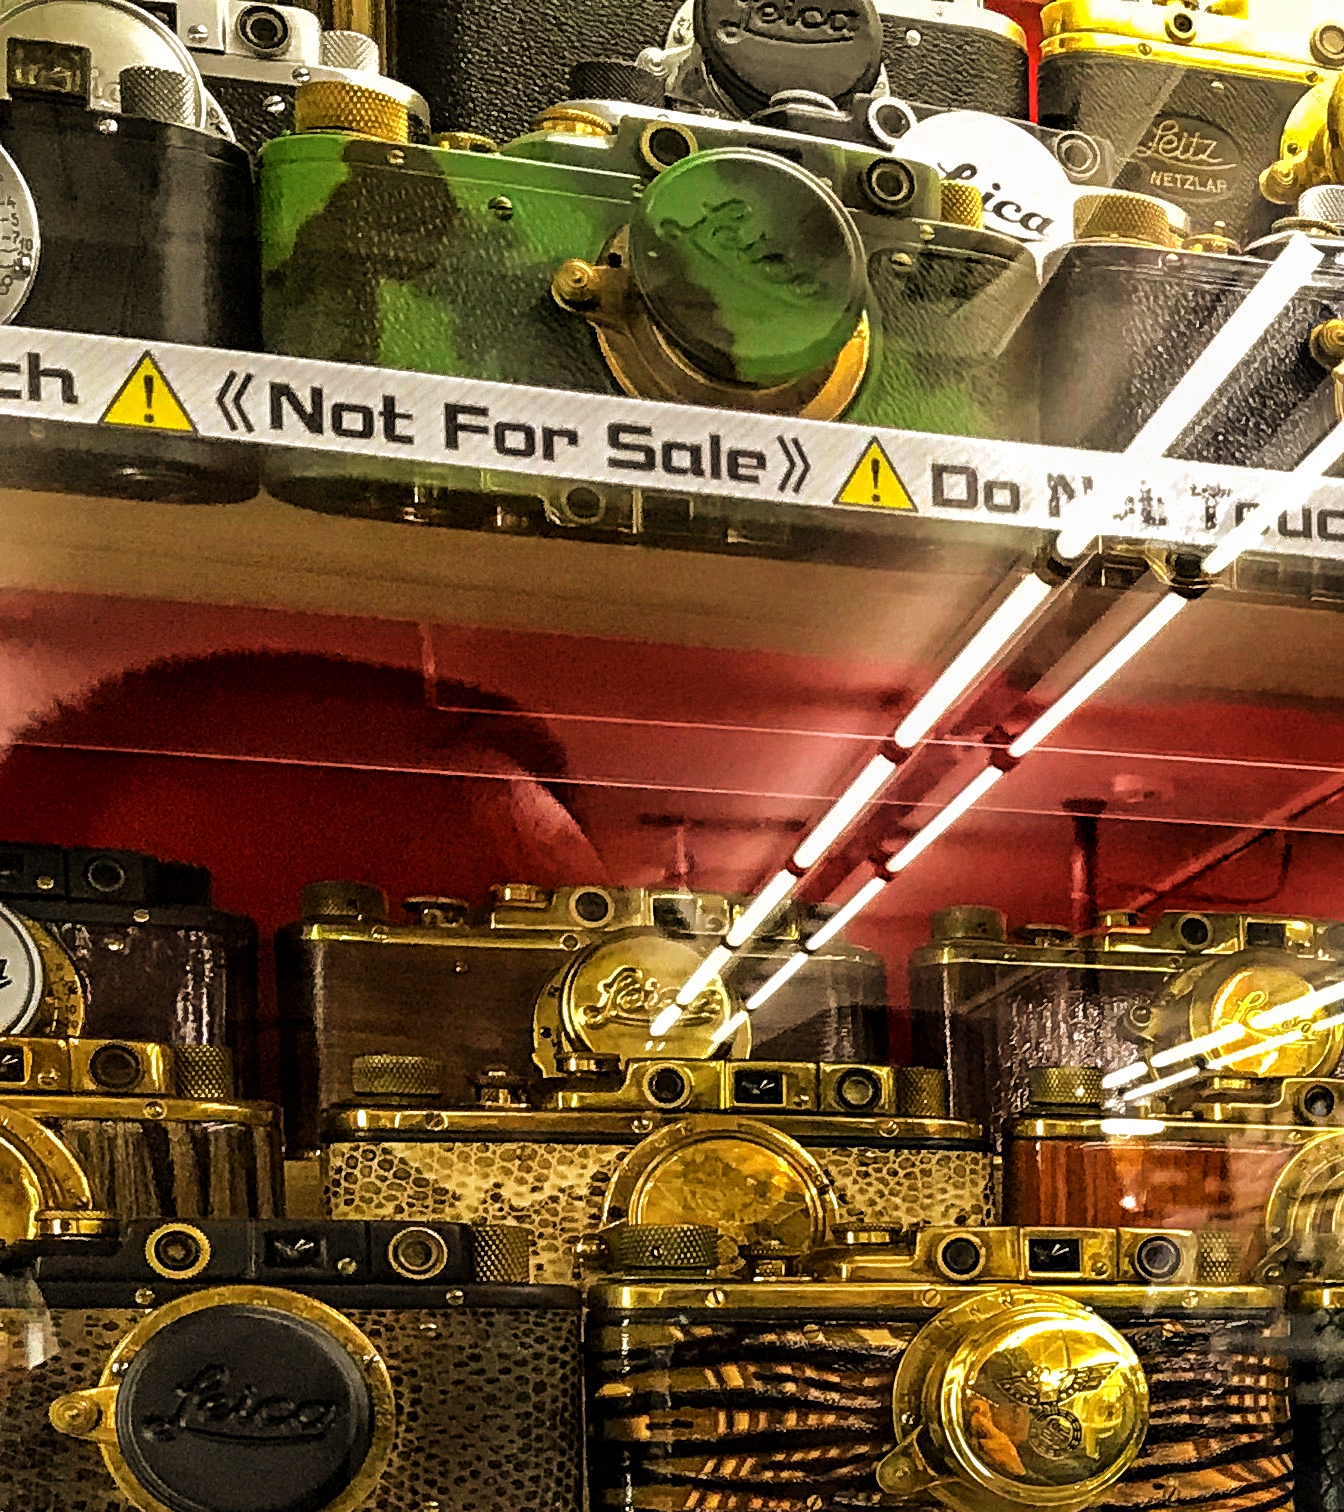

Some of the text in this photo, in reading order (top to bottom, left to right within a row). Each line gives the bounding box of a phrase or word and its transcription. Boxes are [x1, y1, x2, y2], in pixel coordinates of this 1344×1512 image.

[938, 160, 1056, 241] Lica
[443, 403, 579, 462] For
[930, 462, 1021, 515] Do
